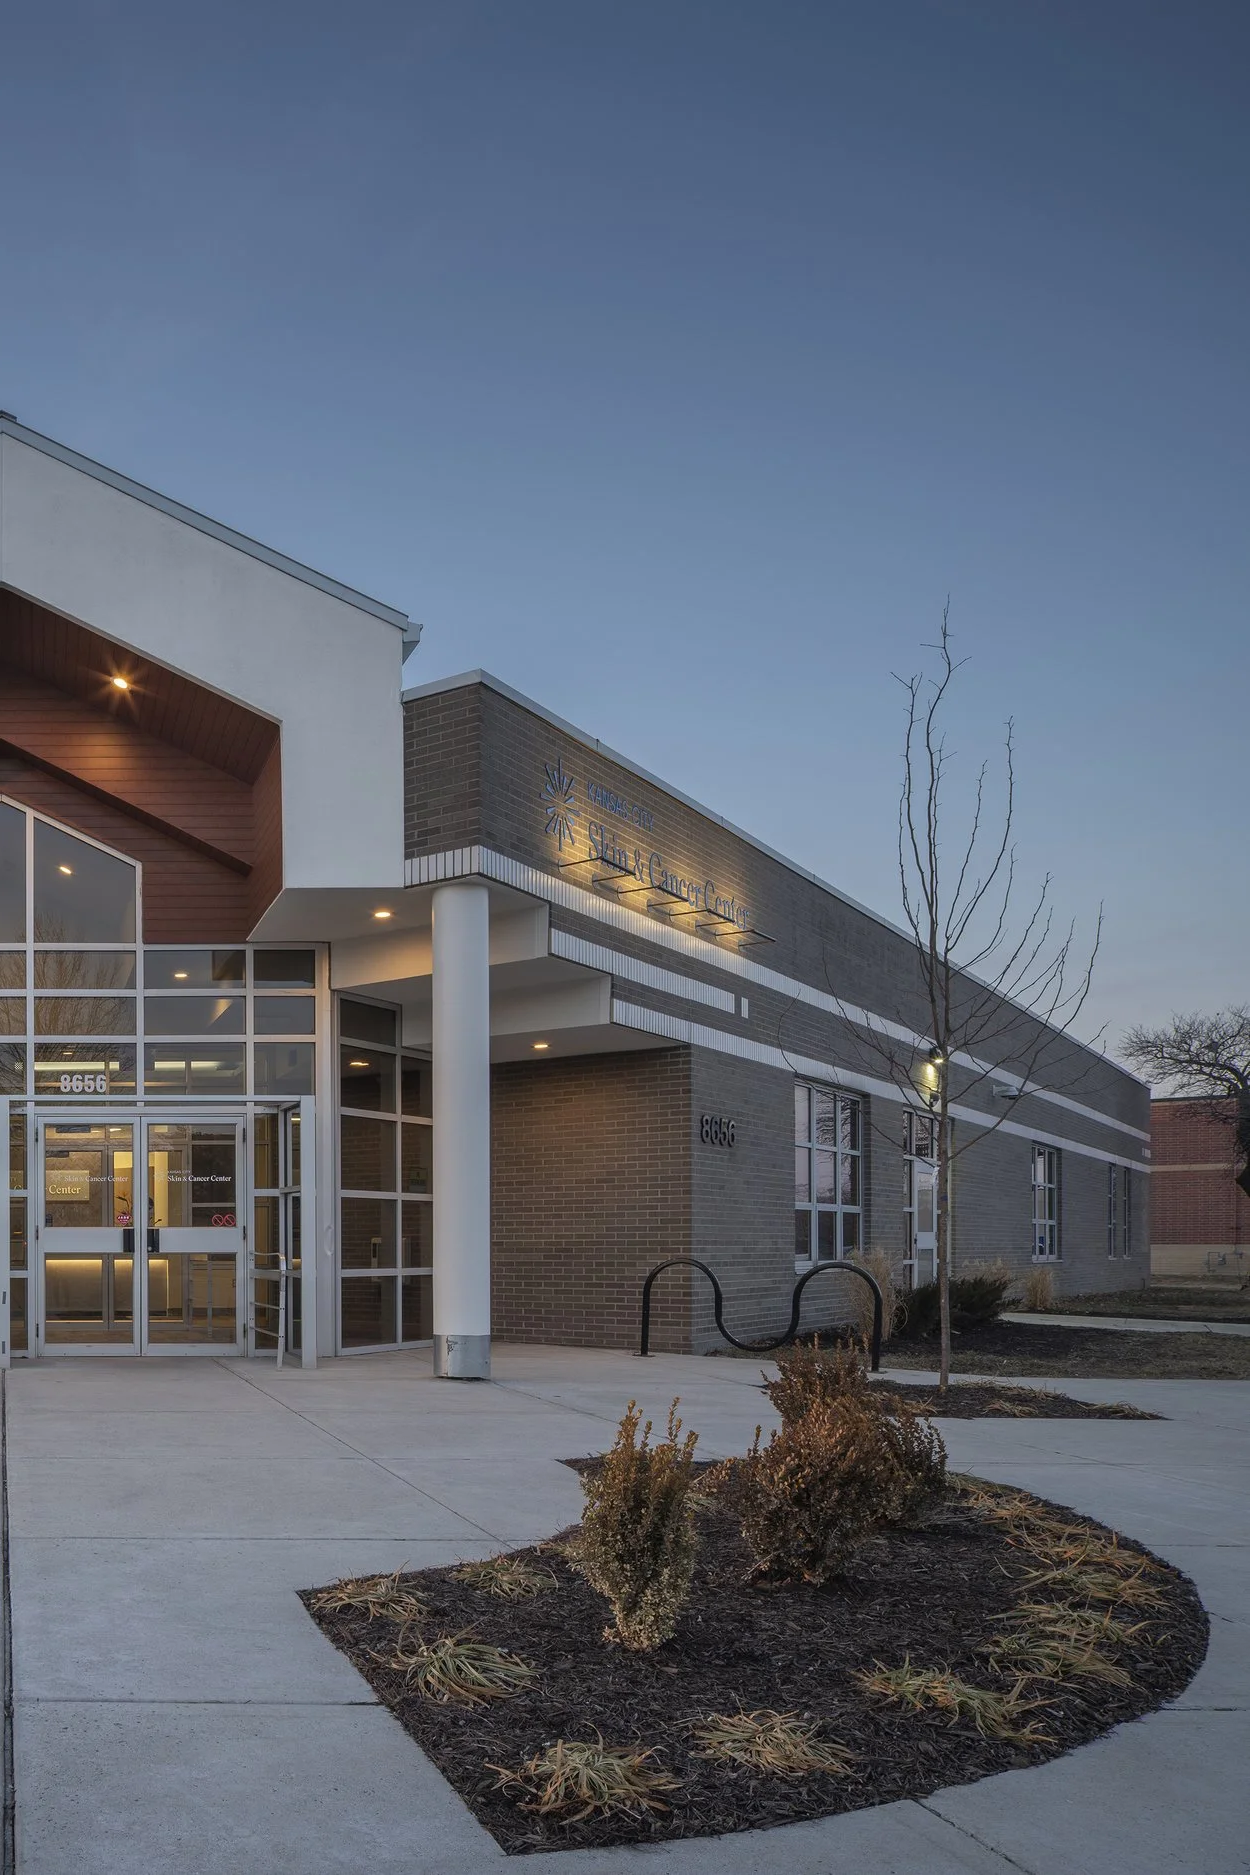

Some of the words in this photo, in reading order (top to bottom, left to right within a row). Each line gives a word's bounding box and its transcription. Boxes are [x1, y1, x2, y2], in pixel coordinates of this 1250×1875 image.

[588, 781, 629, 820] KANSAS
[631, 804, 654, 832] CITY
[589, 821, 630, 873] Skin
[634, 847, 645, 884] &
[649, 853, 701, 909] Cancer
[704, 880, 750, 931] Center
[60, 1074, 107, 1093] 8656
[701, 1114, 735, 1149] 8656
[49, 1184, 81, 1194] Center
[168, 1174, 182, 1182] Skin
[188, 1174, 209, 1182] Cancer
[210, 1174, 231, 1182] Center
